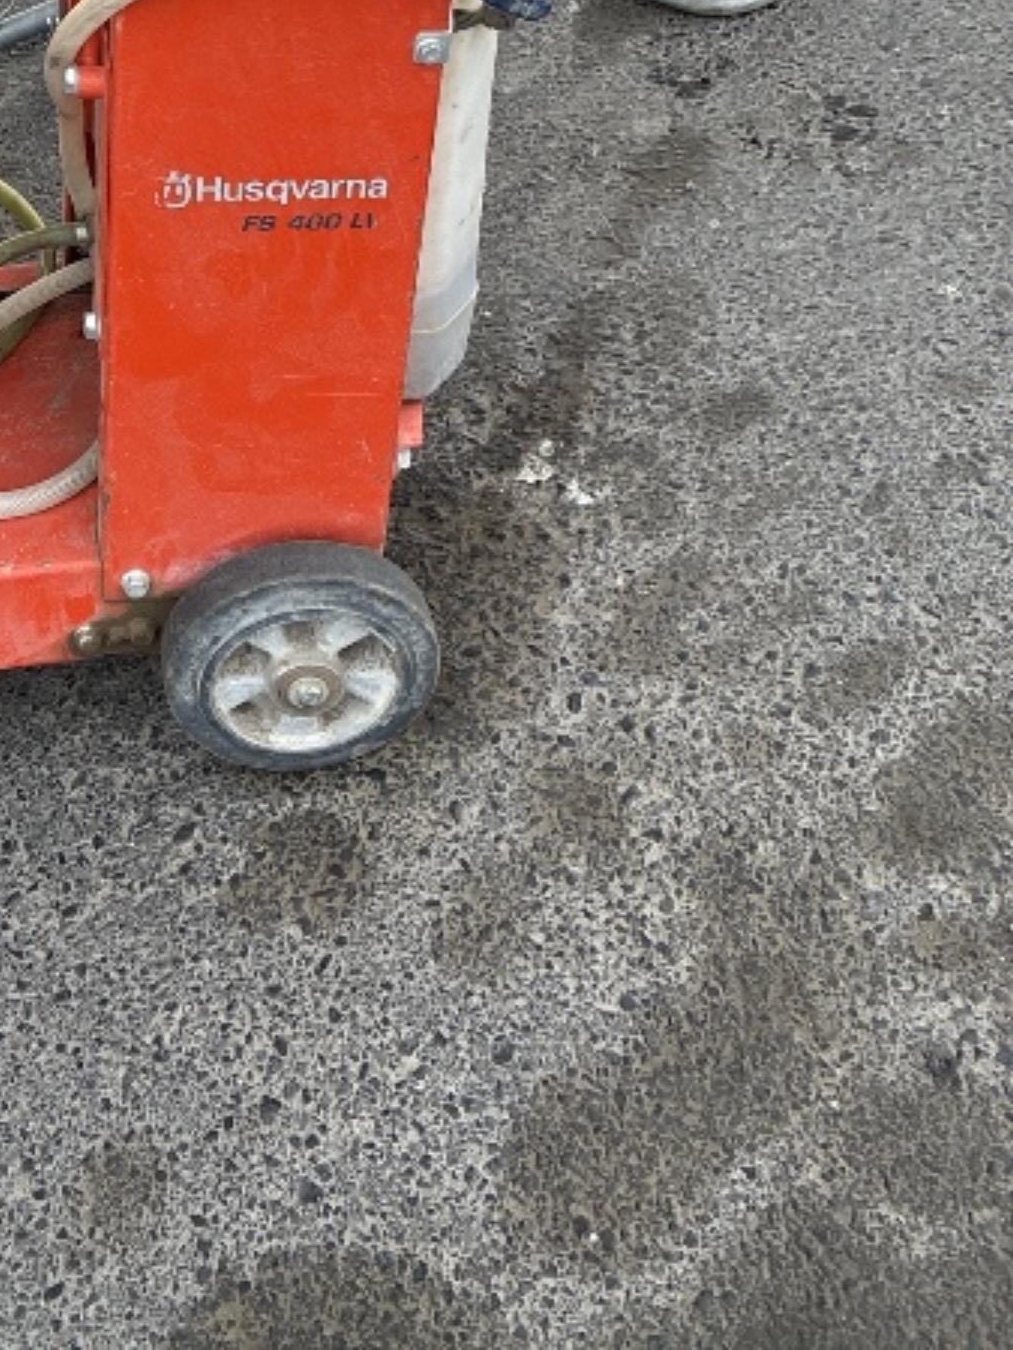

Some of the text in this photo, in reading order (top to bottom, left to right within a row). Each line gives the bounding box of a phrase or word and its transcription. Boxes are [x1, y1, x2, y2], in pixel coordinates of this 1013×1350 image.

[195, 175, 388, 205] Husqvarna
[241, 214, 277, 232] FS
[288, 212, 343, 230] 400
